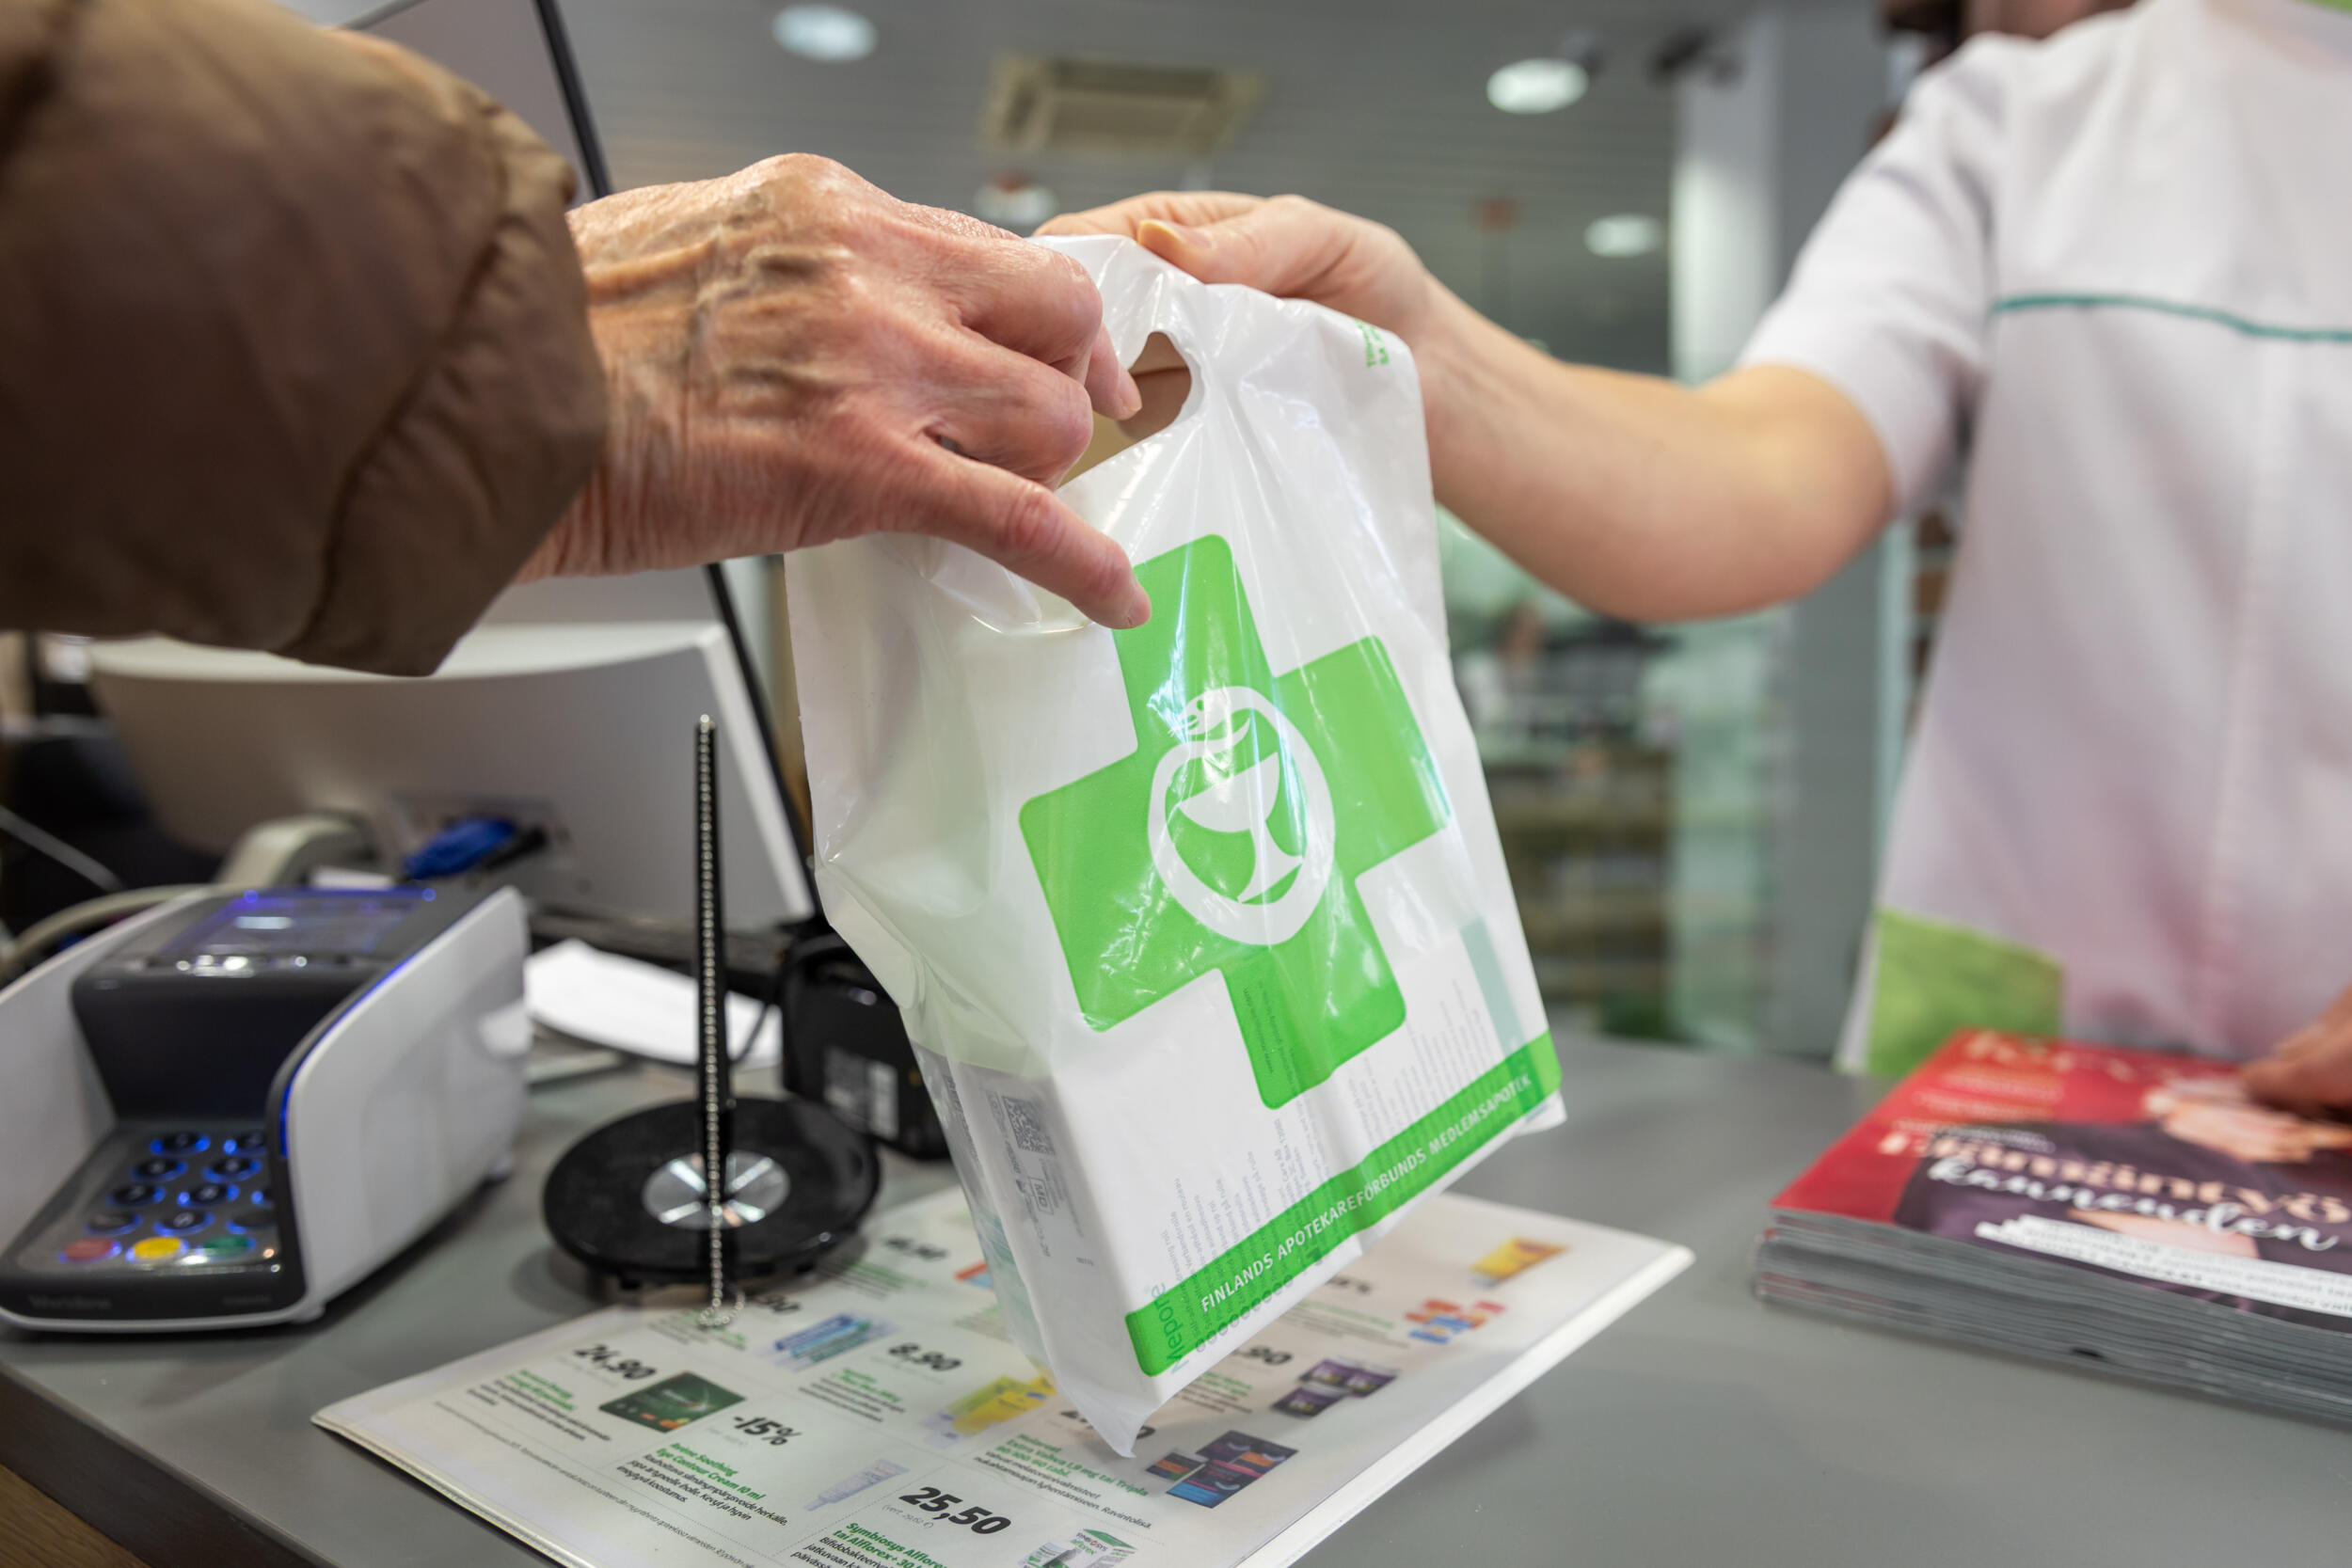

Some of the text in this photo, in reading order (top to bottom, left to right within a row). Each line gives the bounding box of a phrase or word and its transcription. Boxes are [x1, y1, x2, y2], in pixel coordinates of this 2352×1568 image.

[1201, 1253, 1274, 1312] FINLANDS
[1278, 1148, 1426, 1259] APOTEKAREFÖRBUNDS
[1428, 1073, 1532, 1155] MEDLEMSAPOTEK
[1151, 1282, 1189, 1374] Mepore
[733, 1416, 802, 1446] -15%
[707, 1472, 739, 1490] Cream
[737, 1485, 752, 1494] 10
[747, 1491, 767, 1500] ml
[726, 1506, 752, 1521] hyvin
[898, 1486, 1011, 1534] 25,50
[833, 1529, 849, 1540] tai
[848, 1537, 898, 1561] Alflorex+
[846, 1522, 906, 1552] Symbiosys
